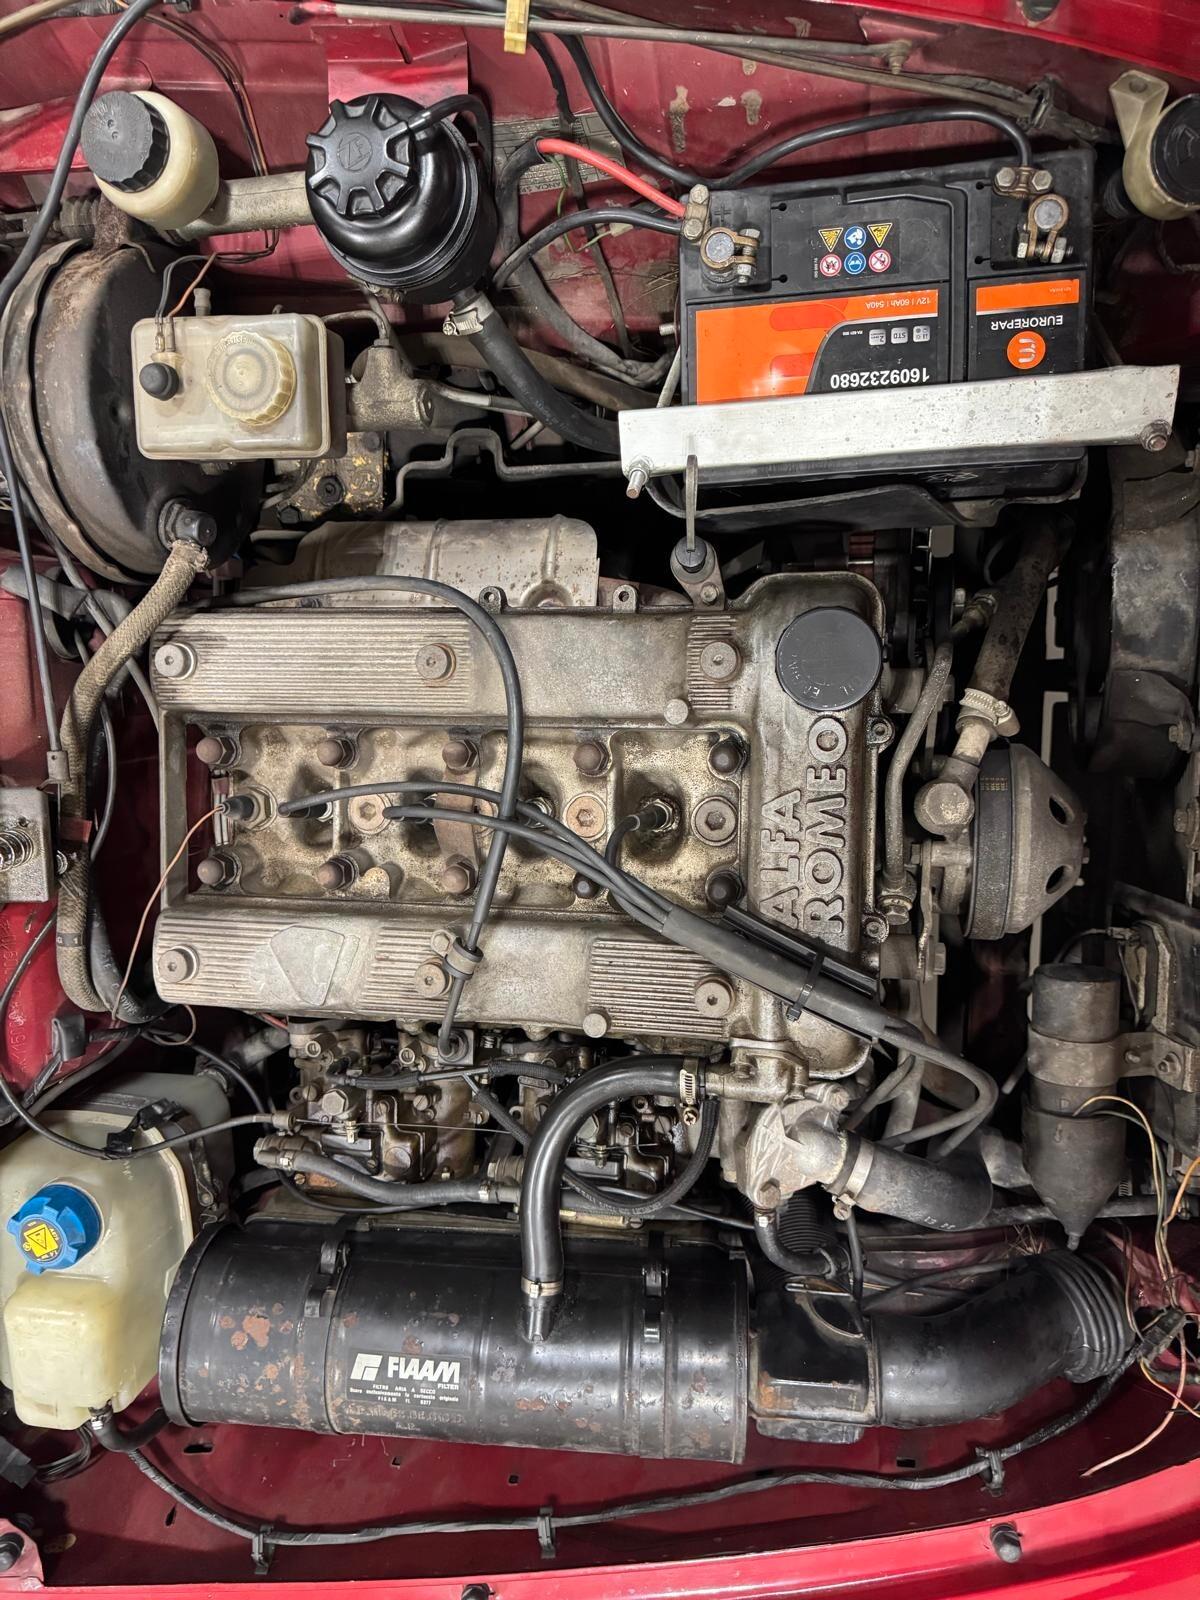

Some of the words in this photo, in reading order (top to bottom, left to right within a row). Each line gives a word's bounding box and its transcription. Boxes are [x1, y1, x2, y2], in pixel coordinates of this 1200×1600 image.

[865, 300, 885, 309] 540A
[891, 298, 910, 307] 60Ah
[916, 297, 930, 305] 12V
[990, 315, 1063, 331] EUROREPAR
[830, 367, 930, 389] 1609232680
[803, 717, 848, 934] ROMEO
[759, 789, 801, 929] ALFA
[387, 1355, 461, 1384] FIAAM
[437, 1383, 459, 1391] FILTER
